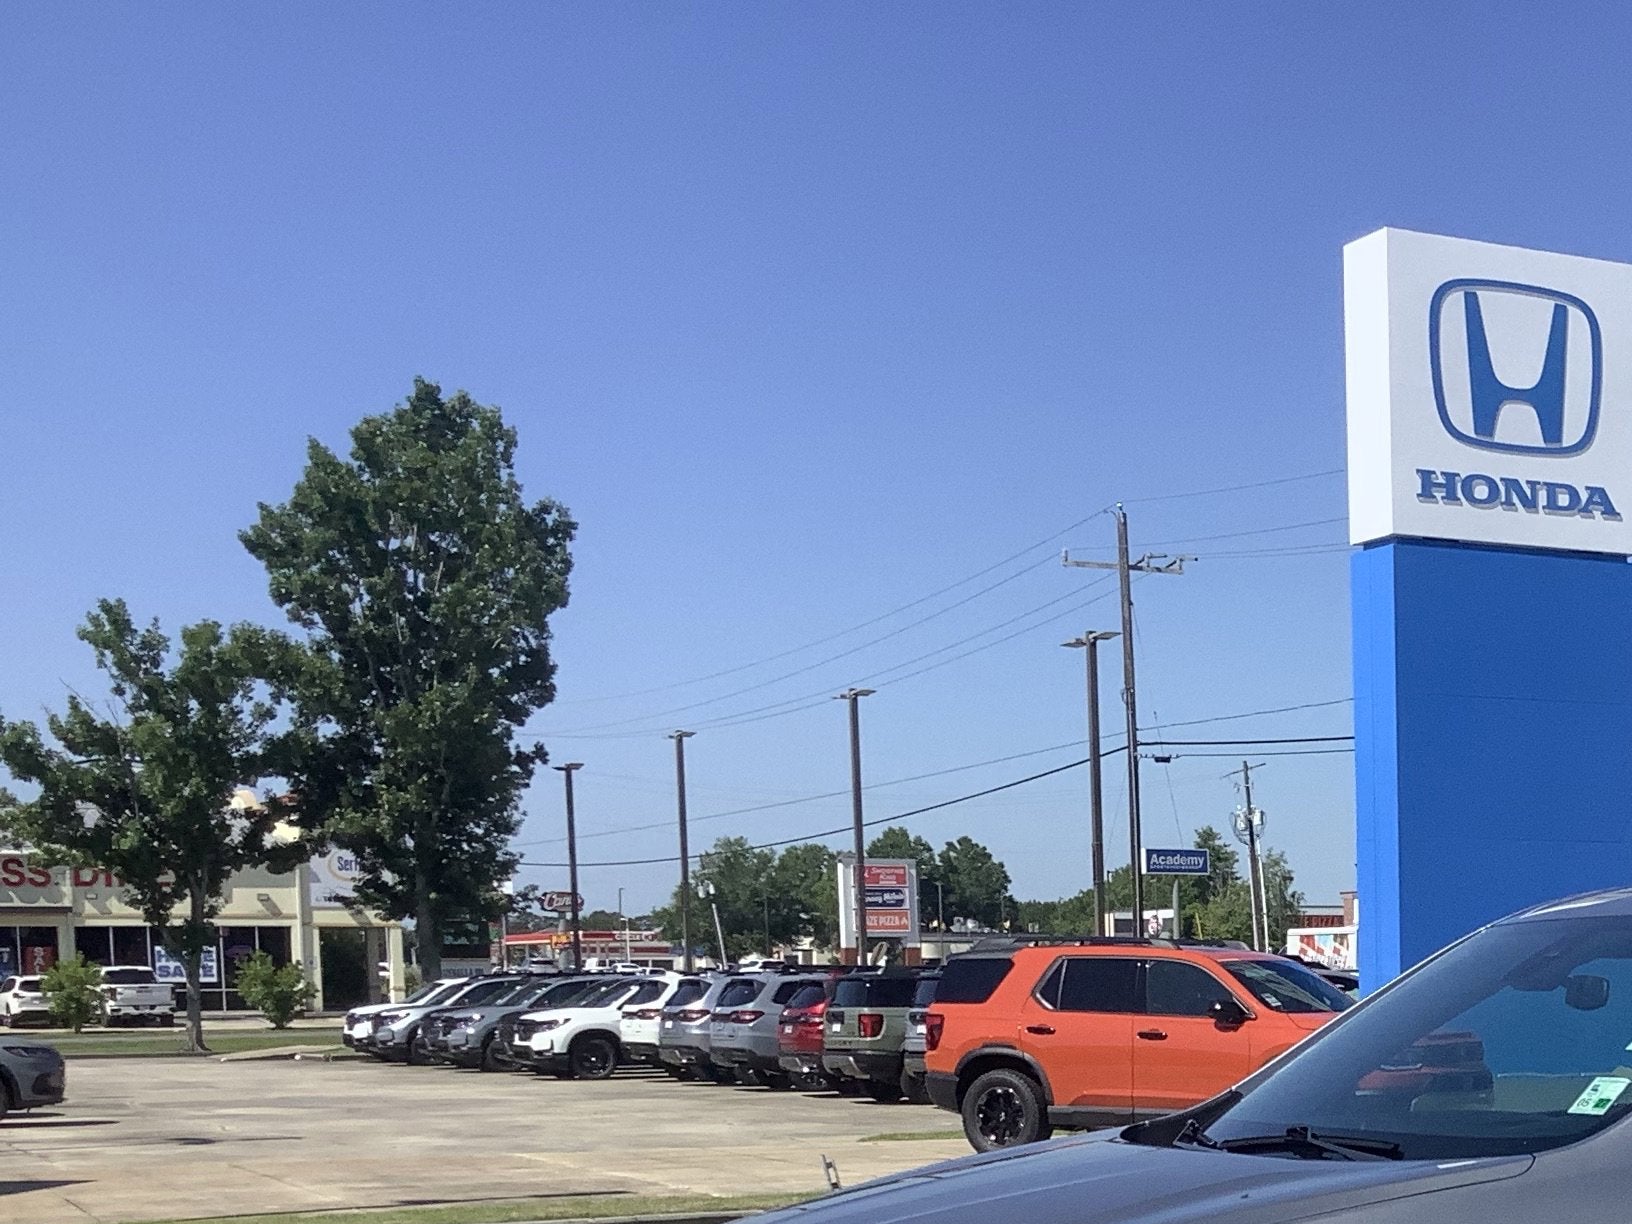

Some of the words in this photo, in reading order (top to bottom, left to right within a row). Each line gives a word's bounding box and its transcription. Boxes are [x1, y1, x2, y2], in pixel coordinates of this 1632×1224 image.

[1415, 467, 1624, 522] HONDA
[1150, 853, 1205, 869] Academy
[879, 916, 900, 927] PIZZA
[33, 947, 45, 975] SAL
[157, 964, 216, 978] SAE
